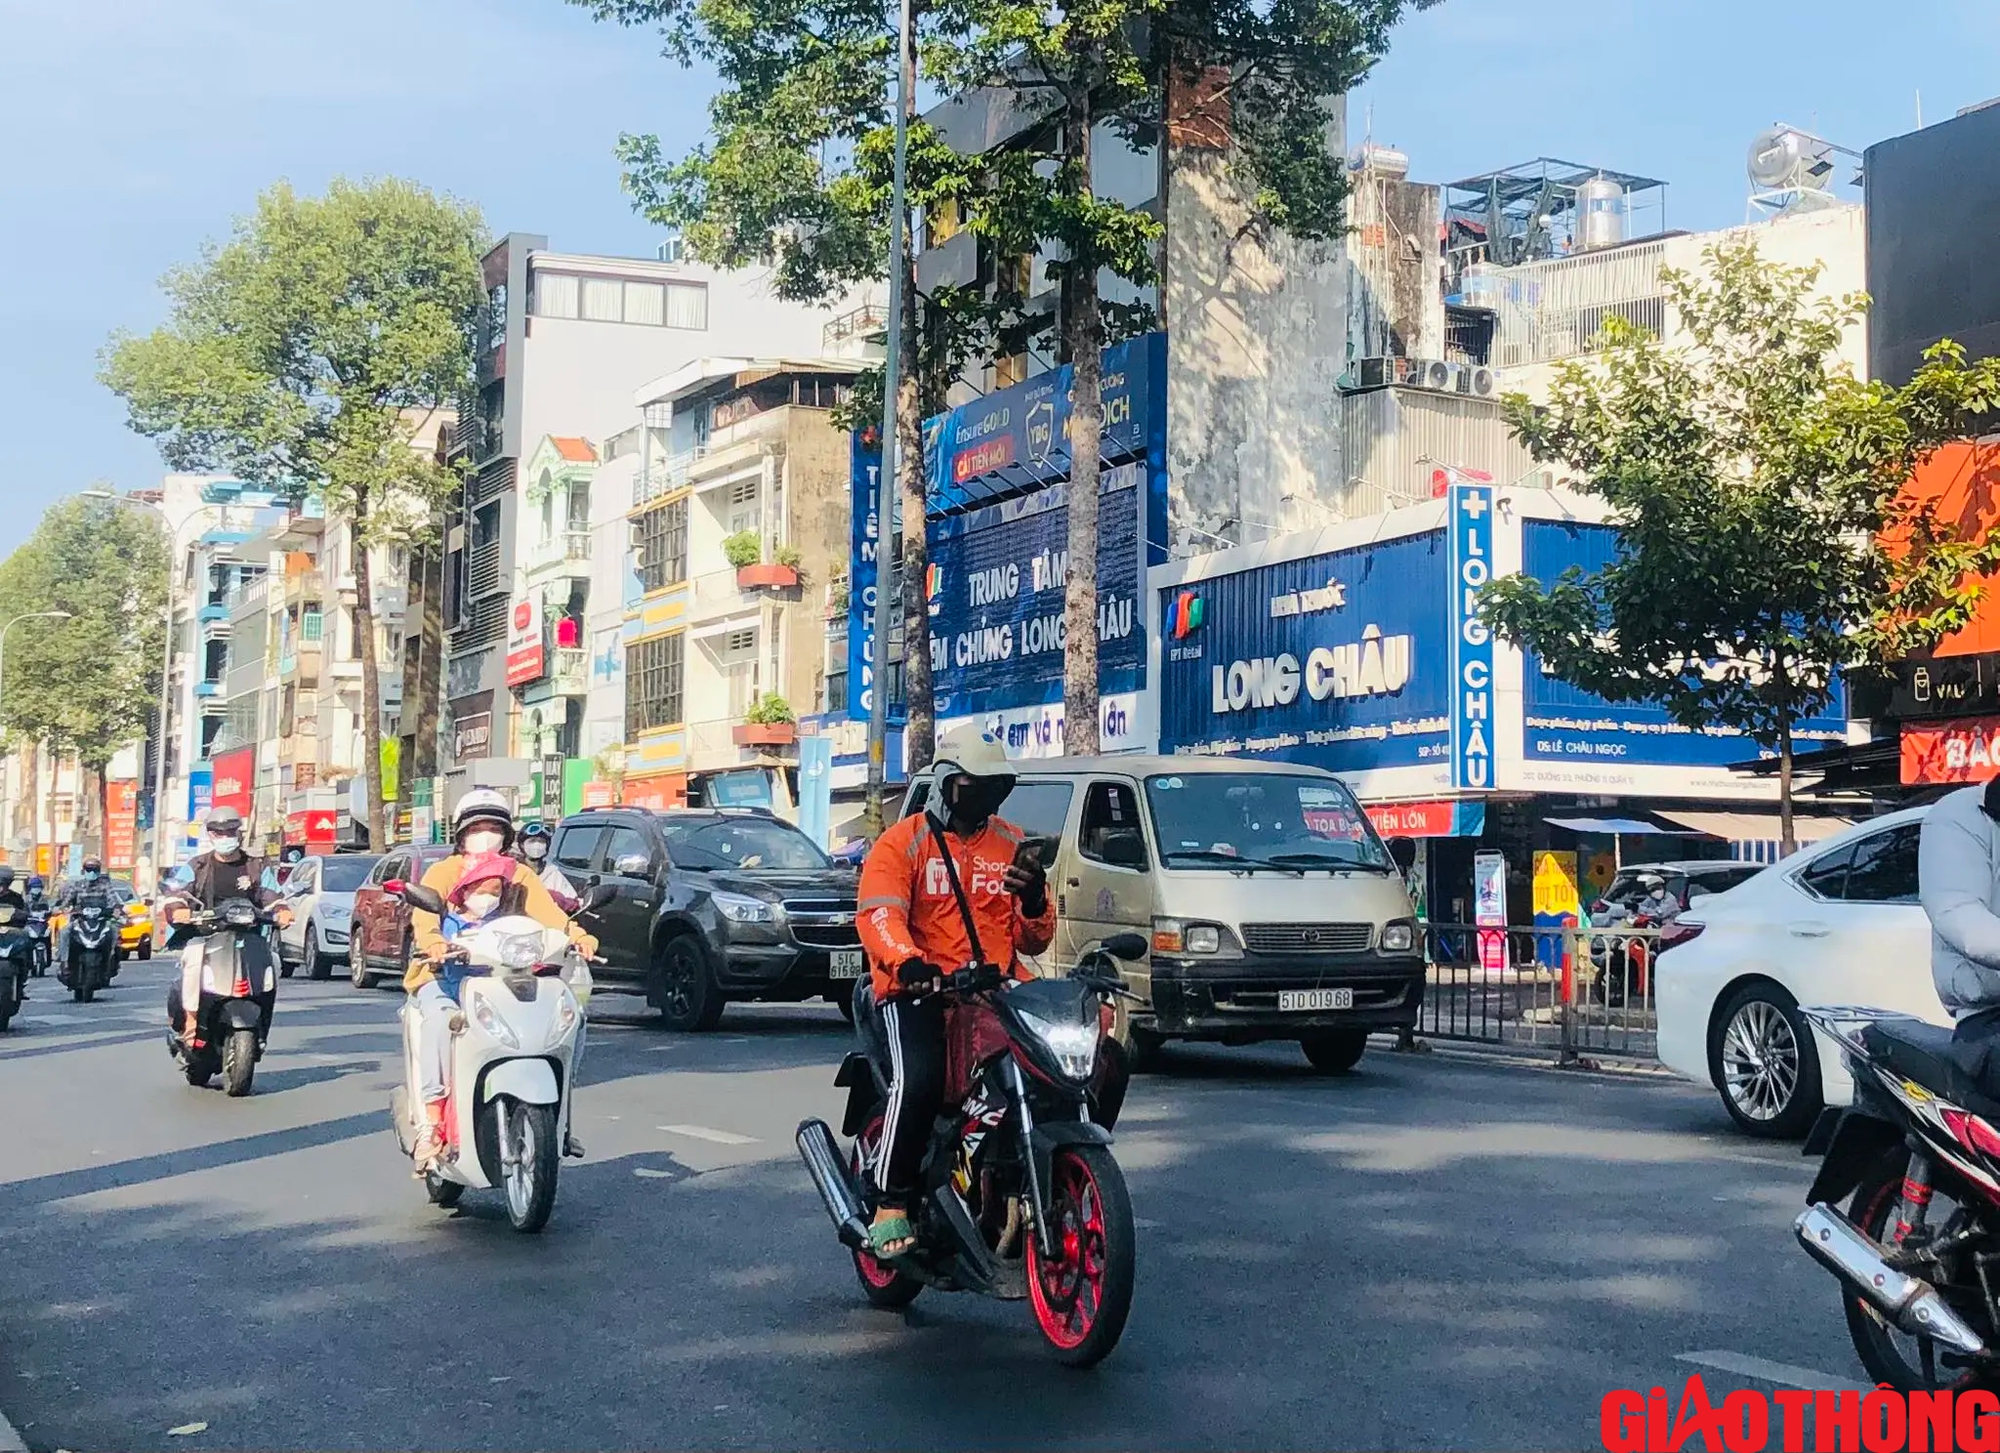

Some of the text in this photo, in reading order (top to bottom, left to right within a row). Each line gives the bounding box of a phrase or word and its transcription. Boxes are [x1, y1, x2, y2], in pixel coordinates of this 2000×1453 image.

[968, 547, 1067, 607] TRUNG TÂM
[955, 615, 1013, 667] CHỦNG
[1020, 612, 1066, 656] LONG
[1097, 594, 1132, 641] HÂU
[1212, 622, 1411, 714] LONG CHÂU
[1462, 528, 1489, 786] LONG CHÂU
[1008, 722, 1030, 748] em
[1552, 739, 1563, 753] LÊ
[1595, 743, 1627, 757] NGỌC
[838, 953, 855, 965] 51C
[1282, 993, 1305, 1009] 51D
